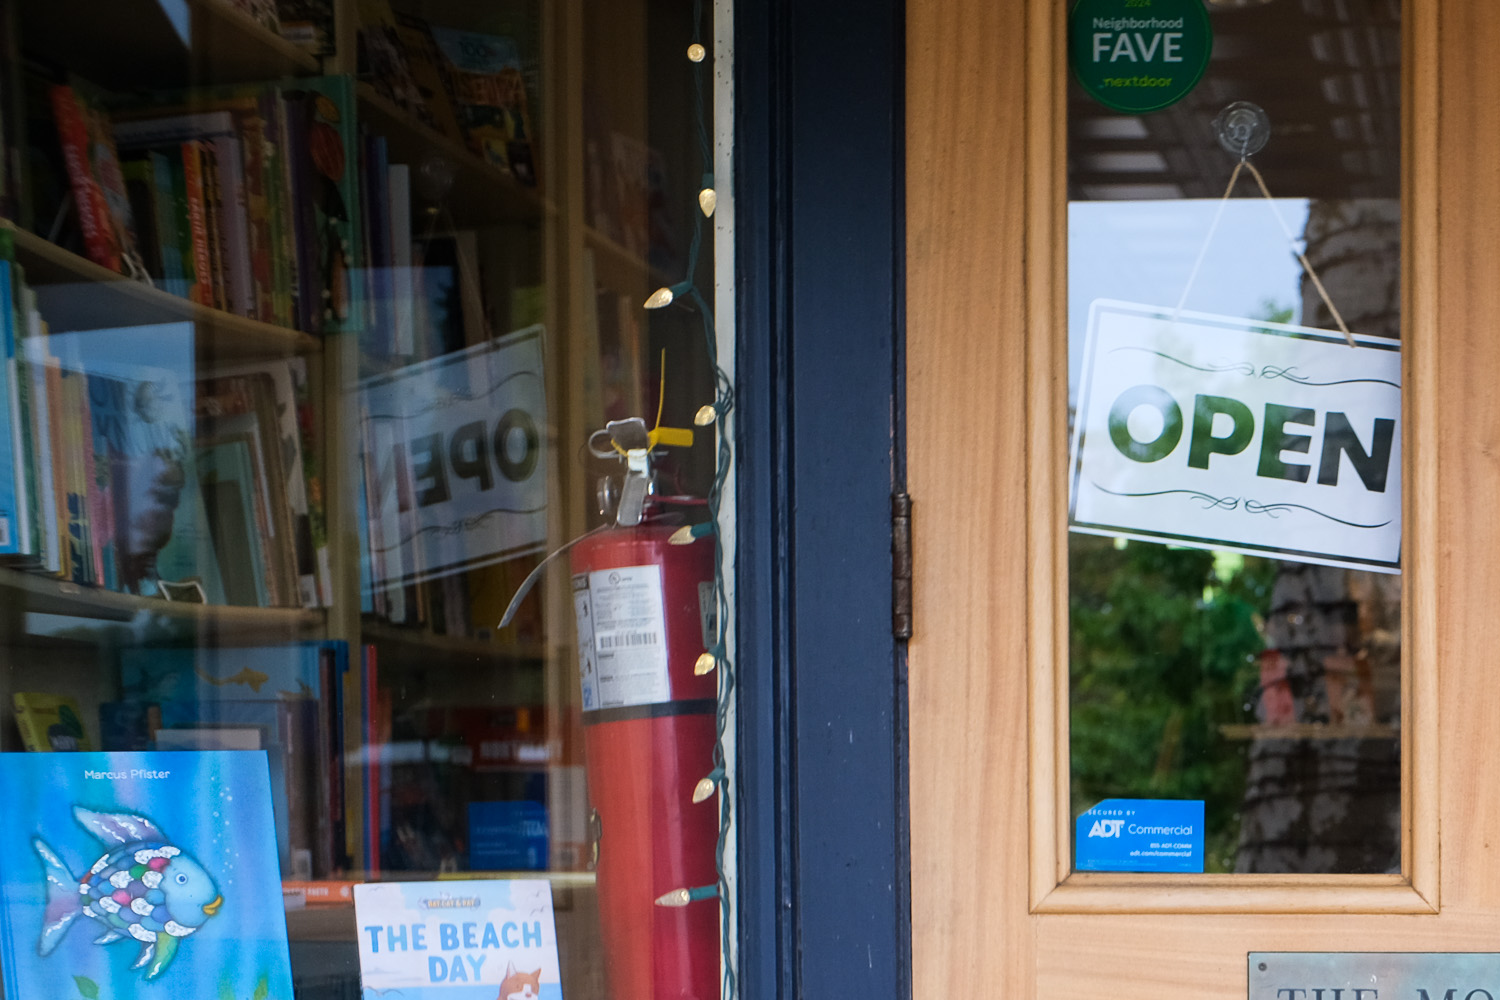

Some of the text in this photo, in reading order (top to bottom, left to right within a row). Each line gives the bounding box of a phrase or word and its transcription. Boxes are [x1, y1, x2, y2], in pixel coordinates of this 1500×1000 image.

[1093, 17, 1184, 31] Neighborhood
[1092, 32, 1184, 62] FAVE
[1103, 75, 1173, 88] nextdoor
[1107, 384, 1395, 493] OPEN
[84, 769, 171, 780] Marcus Pfister
[1088, 819, 1193, 838] ADT Commercial
[1129, 849, 1192, 857] adt.com/commercial
[364, 921, 542, 952] THE BEACH
[428, 953, 487, 983] DAY
